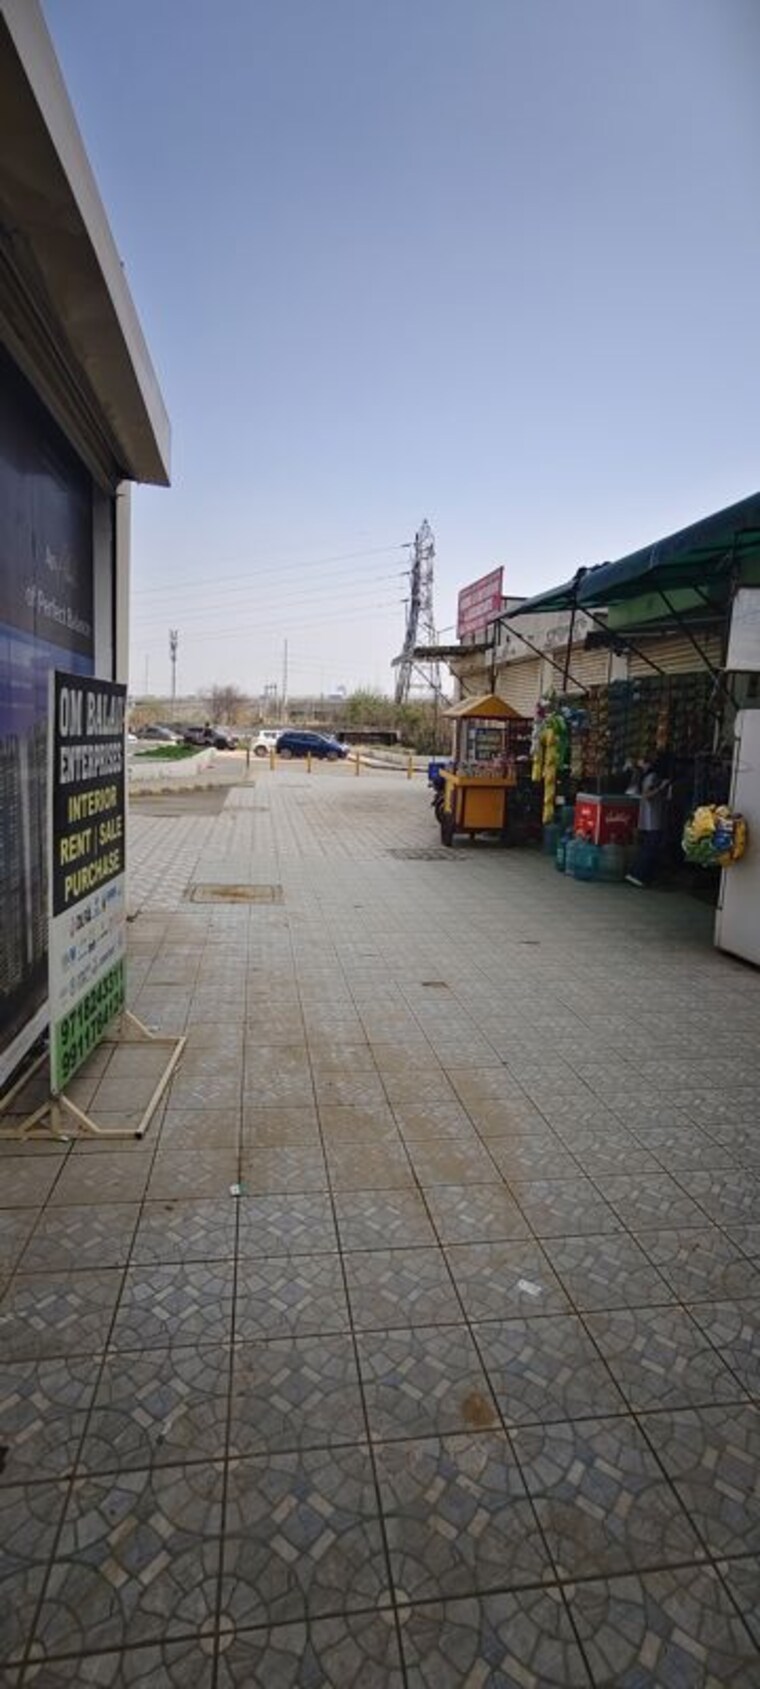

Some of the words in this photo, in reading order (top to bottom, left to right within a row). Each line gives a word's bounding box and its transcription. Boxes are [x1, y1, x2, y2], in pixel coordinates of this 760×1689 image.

[37, 588, 66, 626] Perfect
[59, 686, 83, 738] OM
[60, 743, 122, 784] ENTERPRISES
[68, 785, 117, 824] INTERIOR
[60, 829, 91, 866] RENT
[99, 815, 123, 848] SALE
[64, 849, 120, 903] PURCHASE
